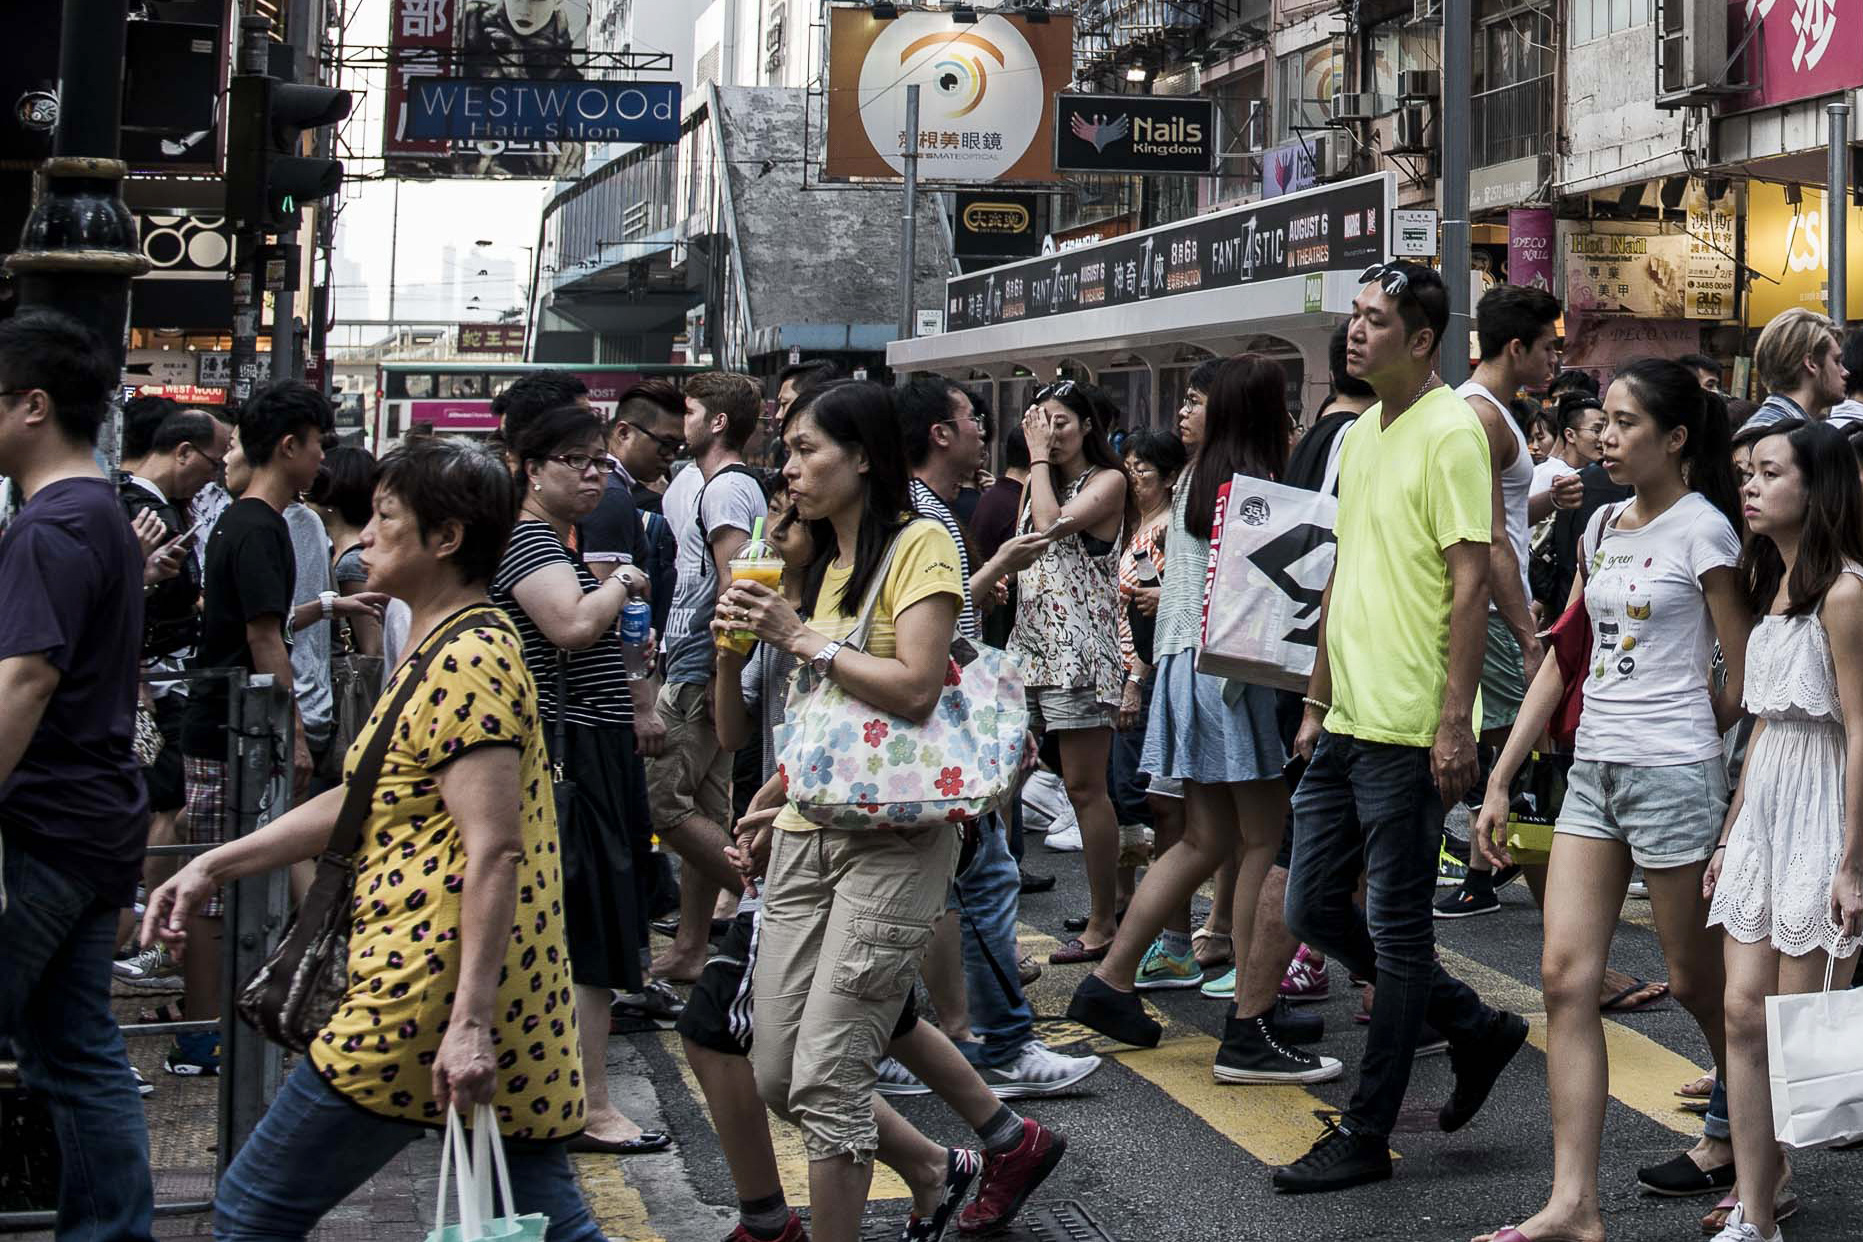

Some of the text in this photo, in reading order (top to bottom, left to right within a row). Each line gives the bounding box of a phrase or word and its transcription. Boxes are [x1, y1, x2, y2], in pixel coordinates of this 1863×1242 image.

[471, 122, 620, 139] Hair Salon
[1133, 117, 1202, 143] Nails
[1133, 143, 1202, 156] Kingdom
[1289, 216, 1319, 242] AUGUST
[1321, 214, 1328, 235] 6
[1513, 237, 1547, 249] DECO
[1570, 233, 1647, 255] Hot Nail
[1171, 240, 1198, 265] 8月6日
[1297, 244, 1329, 266] THEATRES
[1522, 250, 1549, 261] NAIL
[1719, 269, 1733, 279] 2/F
[1598, 283, 1629, 297] 美甲
[165, 385, 190, 394] WEST
[1608, 555, 1634, 570] green
